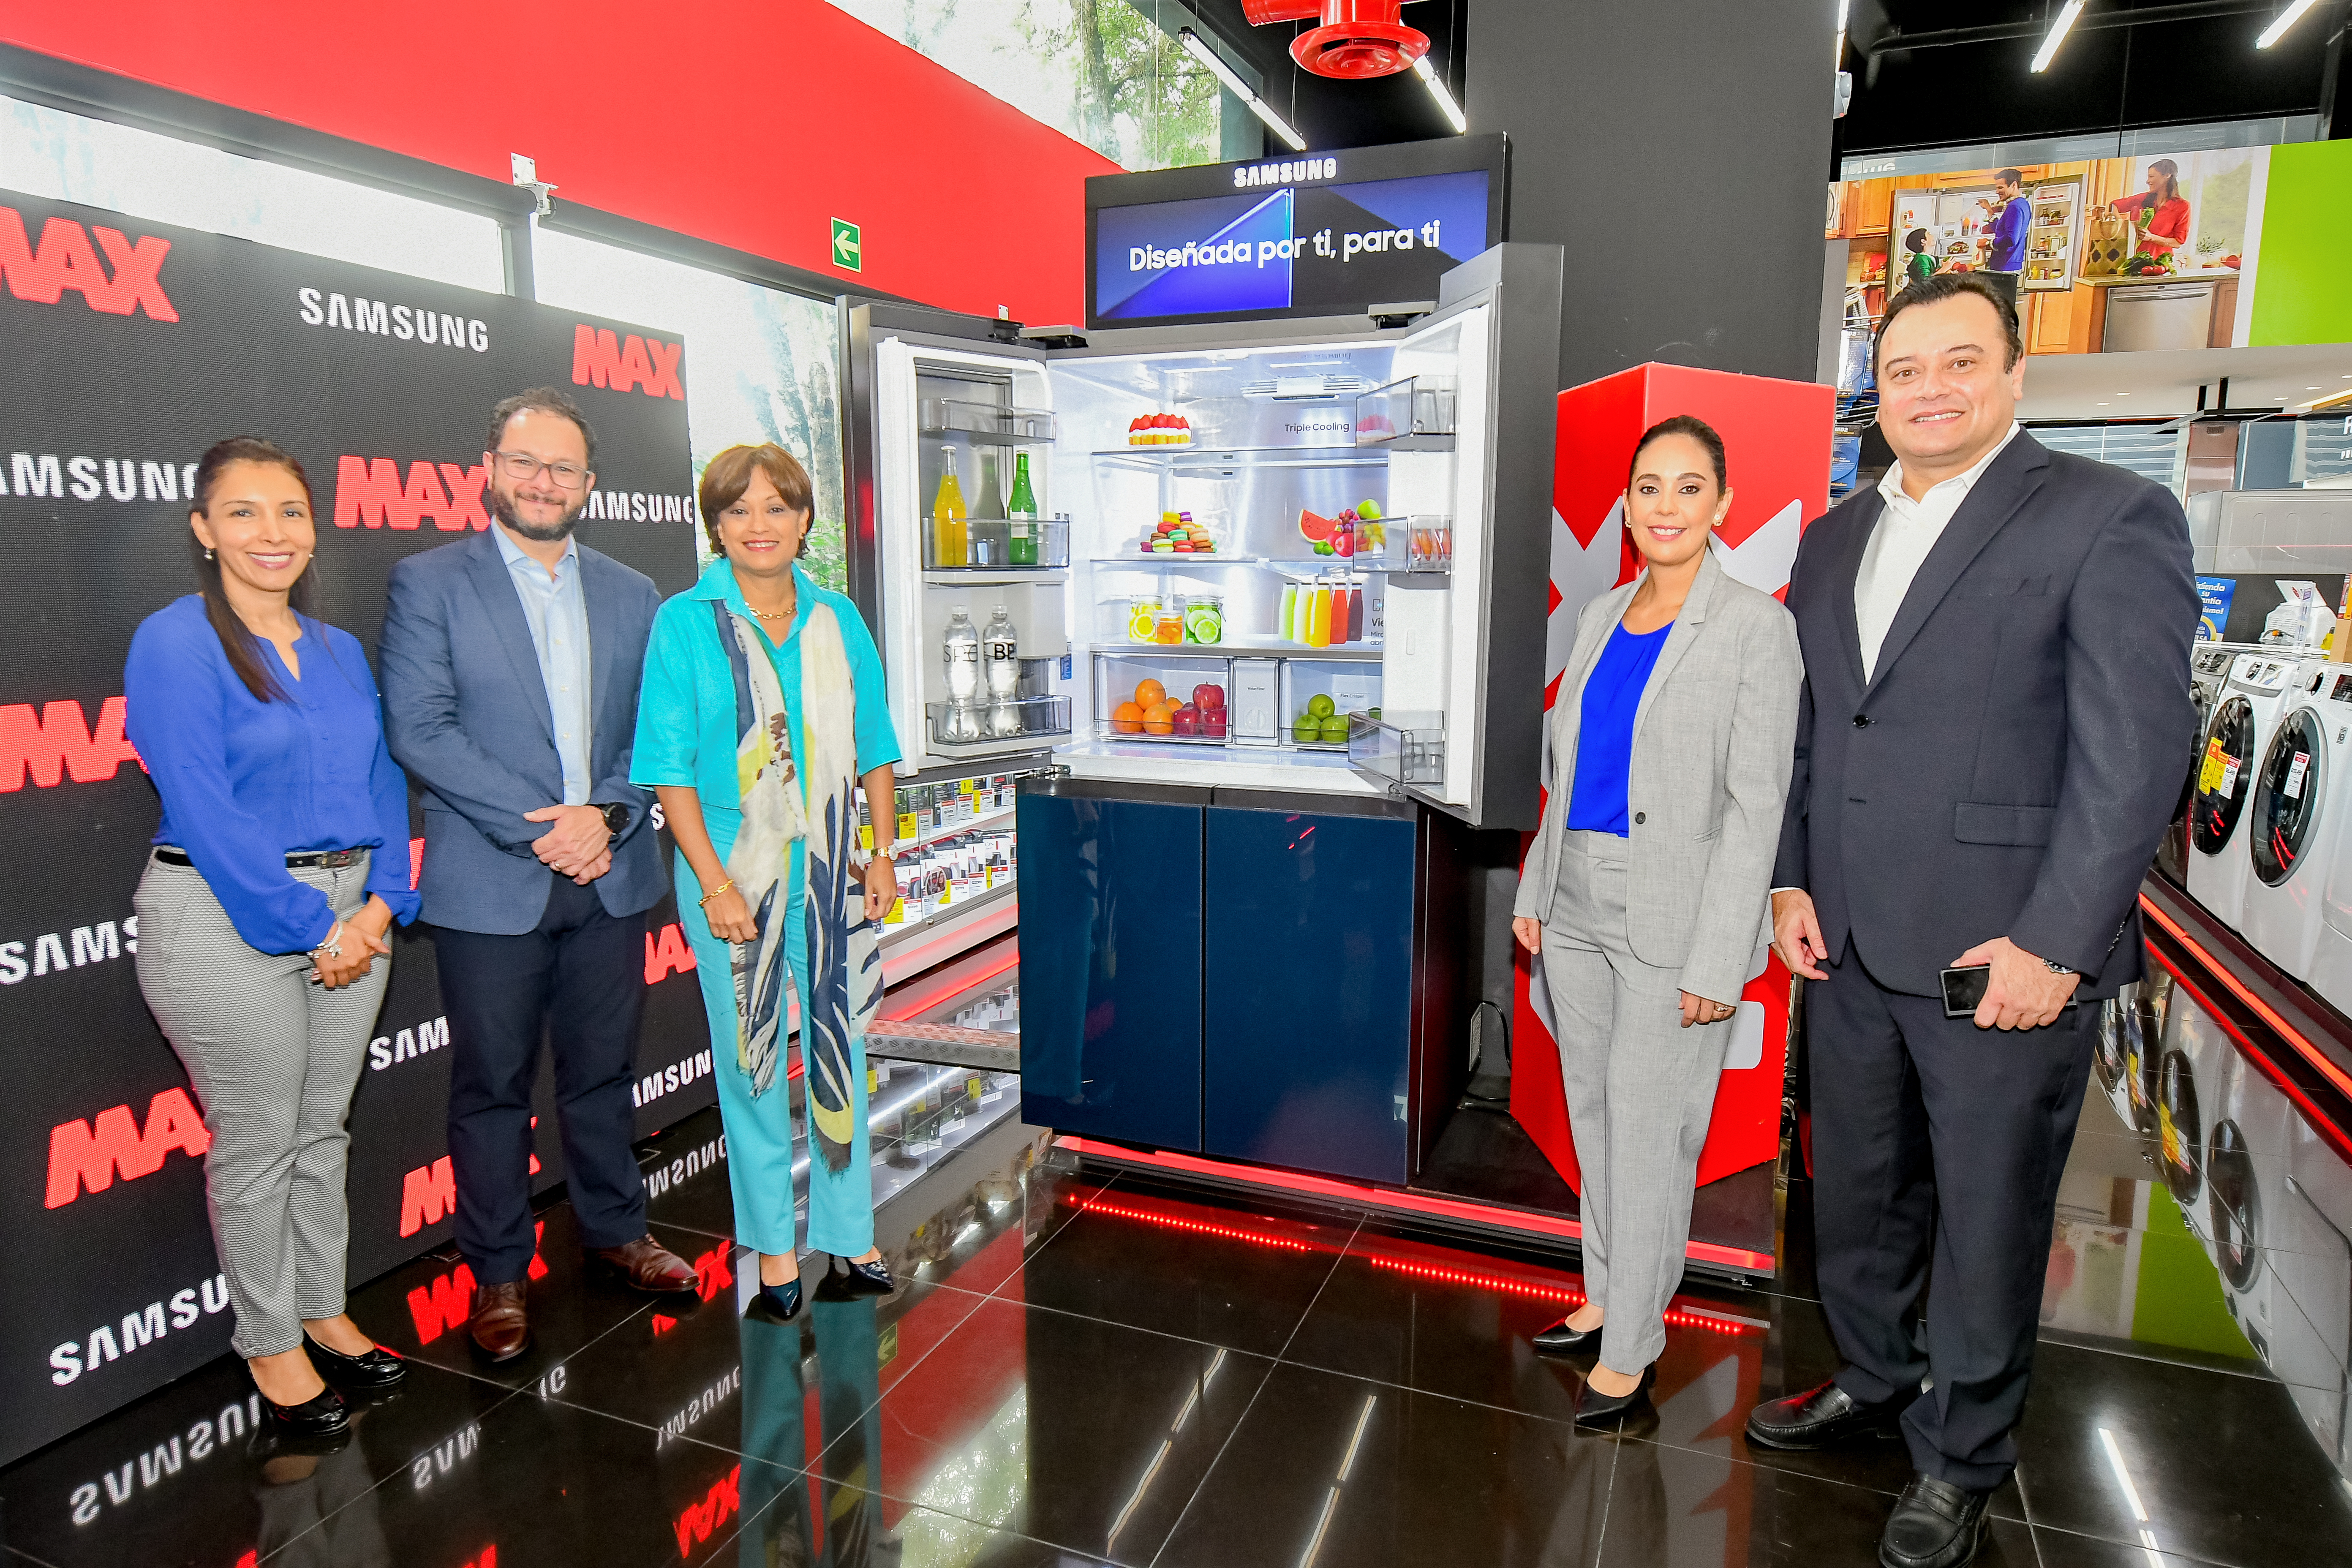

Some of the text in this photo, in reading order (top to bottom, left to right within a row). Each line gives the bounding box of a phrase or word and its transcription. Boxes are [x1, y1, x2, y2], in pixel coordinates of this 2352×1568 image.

[1234, 158, 1337, 188] SAMSUNG
[1130, 219, 1441, 271] Diseñada por ti, para ti
[297, 286, 489, 352] SAMSUNG
[572, 324, 684, 400] MAX
[1285, 422, 1350, 435] Triple Cooling
[0, 452, 199, 502] MSUN
[334, 455, 491, 531] MAX
[44, 1087, 213, 1209] MA
